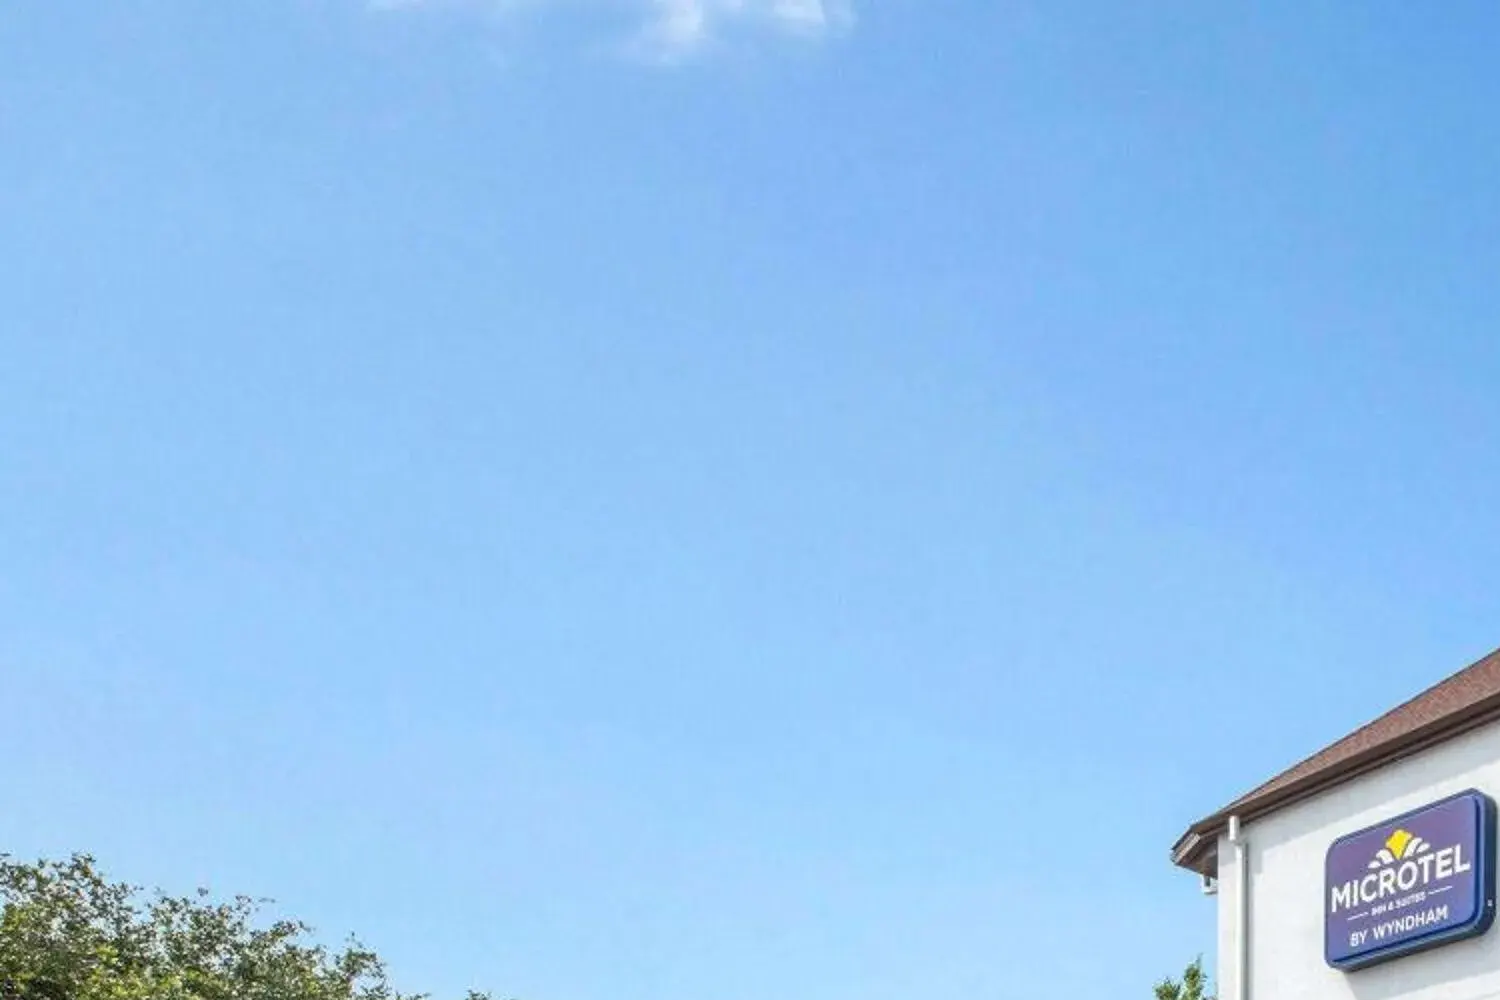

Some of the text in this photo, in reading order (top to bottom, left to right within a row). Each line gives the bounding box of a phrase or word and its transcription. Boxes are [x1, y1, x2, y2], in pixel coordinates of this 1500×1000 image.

[1331, 844, 1471, 913] MICROTEL
[1350, 904, 1449, 947] BY WYNDHAM
